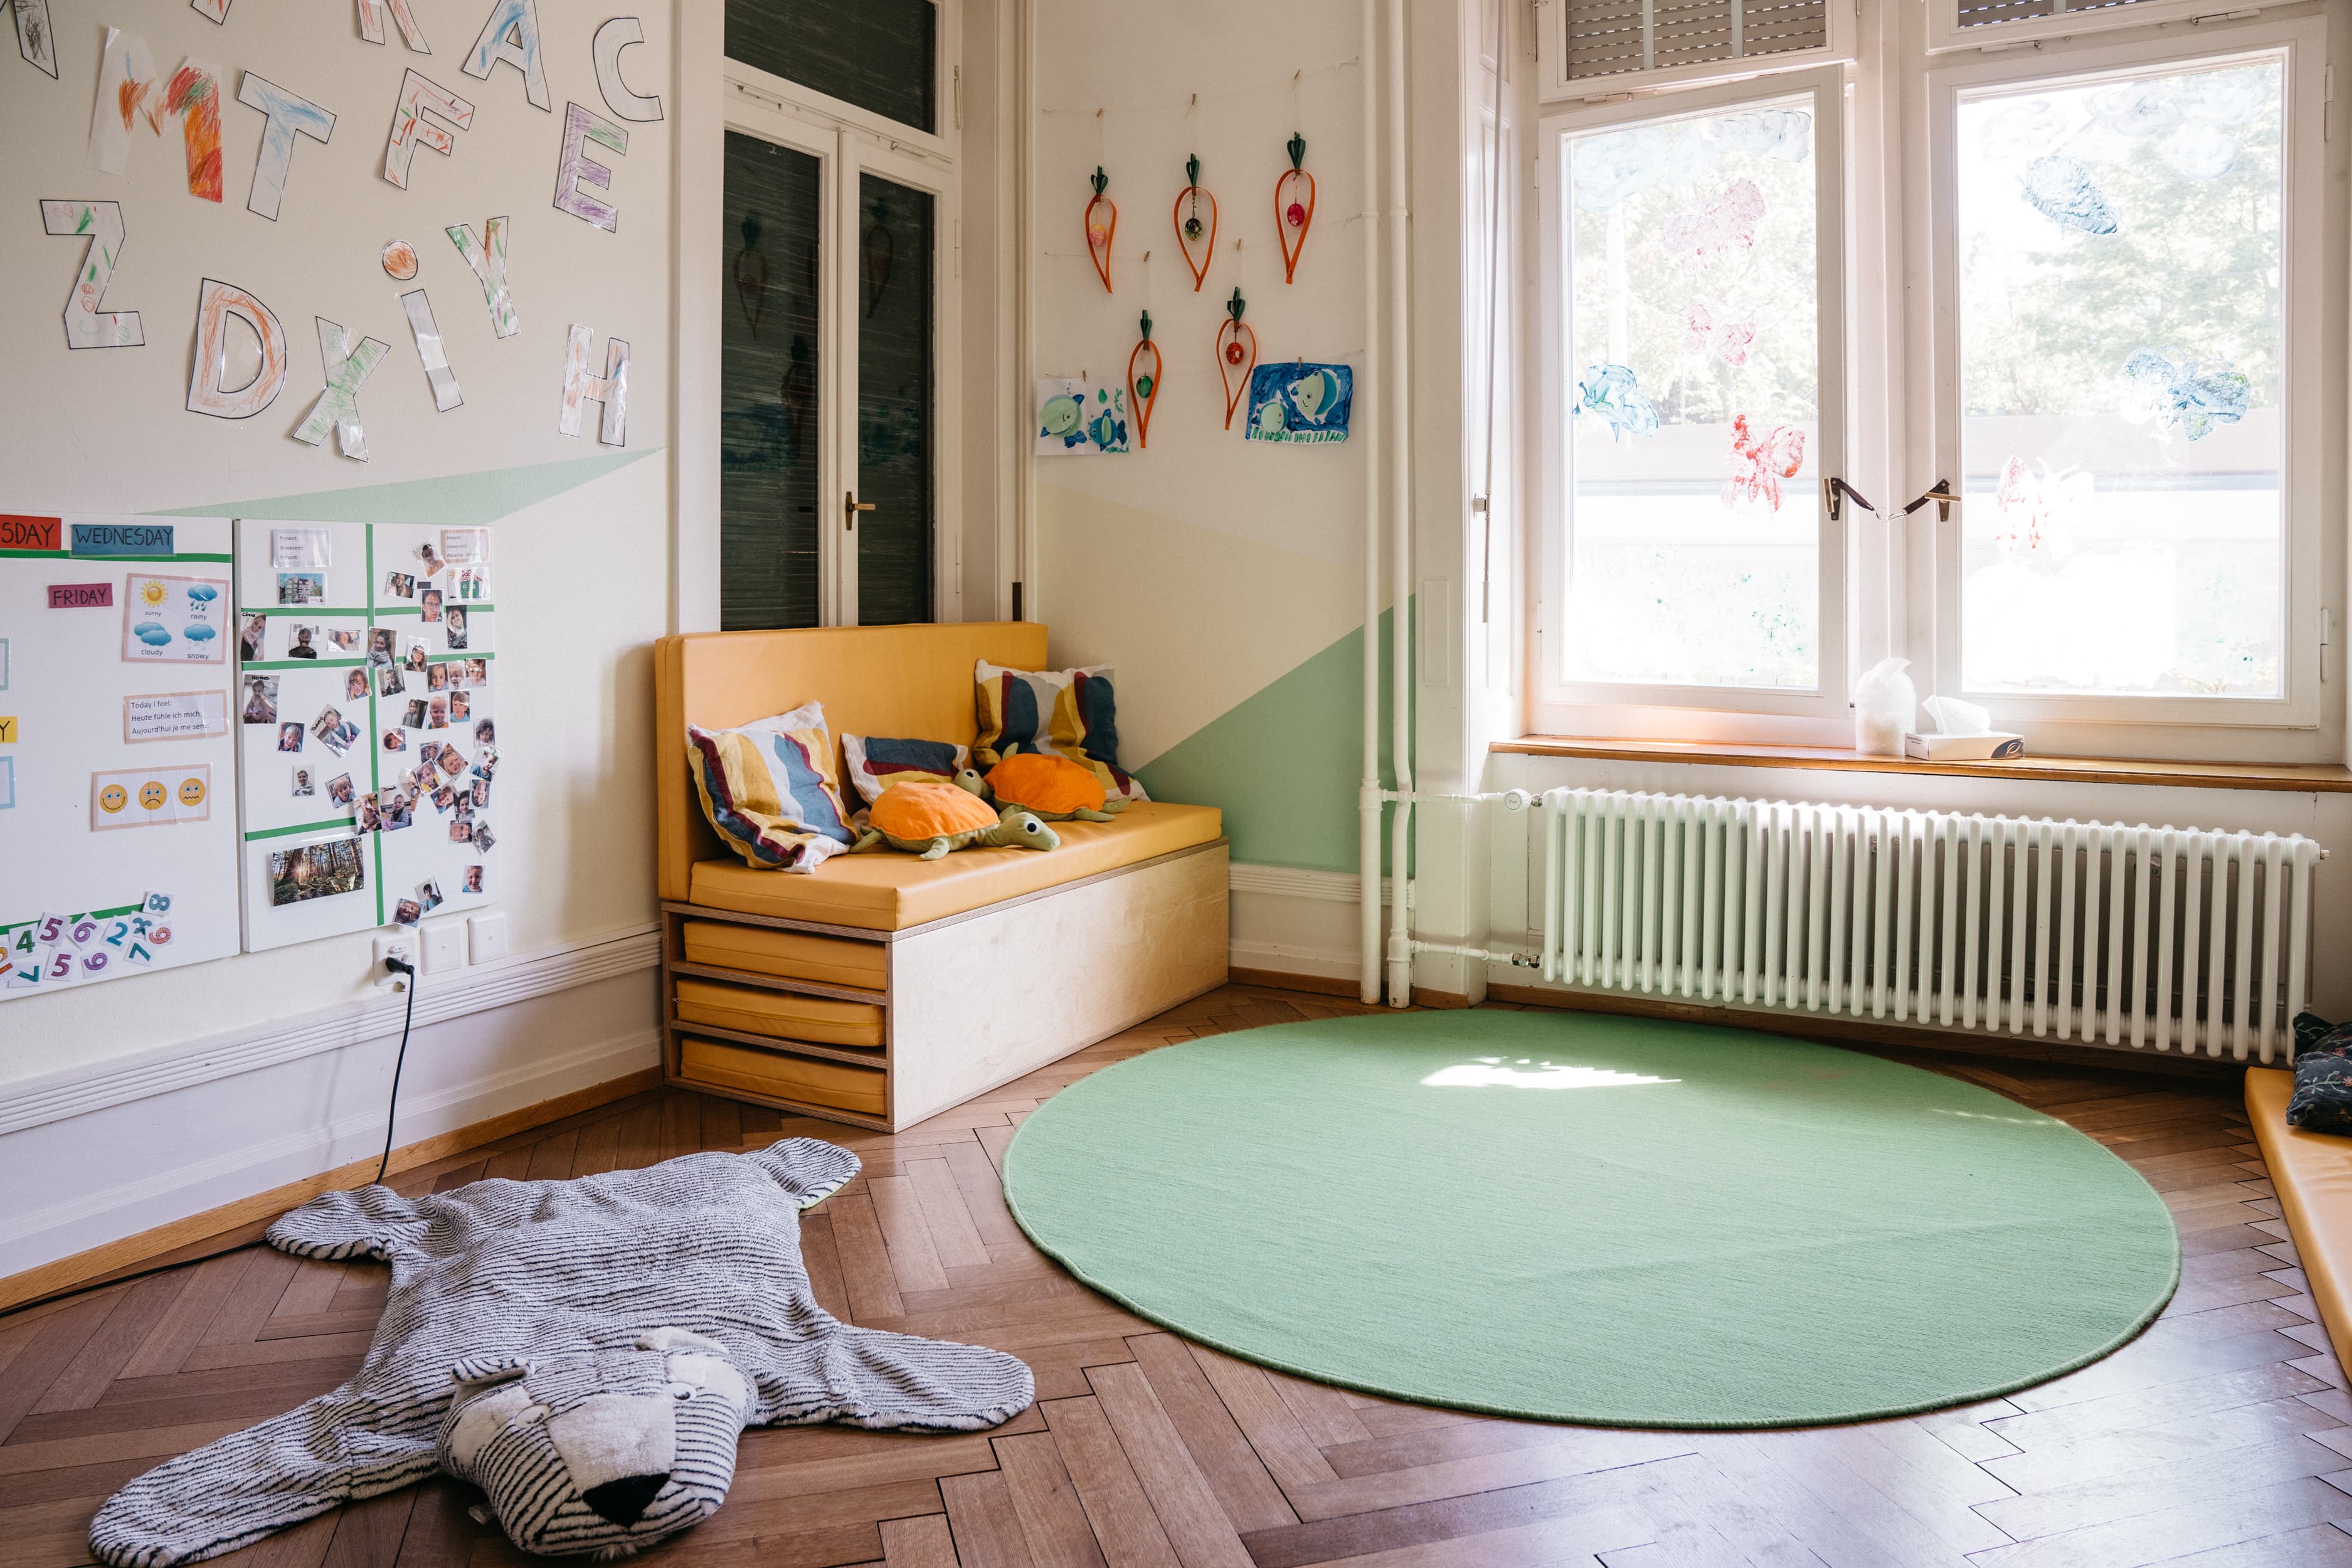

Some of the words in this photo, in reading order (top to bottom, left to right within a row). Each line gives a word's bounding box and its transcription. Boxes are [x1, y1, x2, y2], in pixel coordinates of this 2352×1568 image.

[462, 0, 551, 113] A
[593, 17, 664, 122] C
[86, 26, 223, 204] M
[383, 67, 475, 191] F
[236, 70, 337, 221] T
[553, 101, 628, 233] E
[40, 199, 146, 349] Z
[445, 215, 521, 339] Y
[186, 277, 287, 419] D
[291, 315, 391, 464] X
[559, 324, 630, 447] H
[75, 527, 174, 547] WEDNESDAY
[53, 588, 107, 606] FRIDAY
[141, 649, 163, 657] cloudy
[130, 701, 152, 709] Today
[157, 699, 172, 707] feel:
[132, 725, 171, 735] Aujourd'hui
[149, 894, 171, 911] 8
[16, 930, 36, 953] 4
[40, 918, 63, 941] 5
[73, 922, 97, 943] 6
[106, 922, 129, 946] 2
[129, 943, 151, 961] 7
[51, 953, 72, 977] 5
